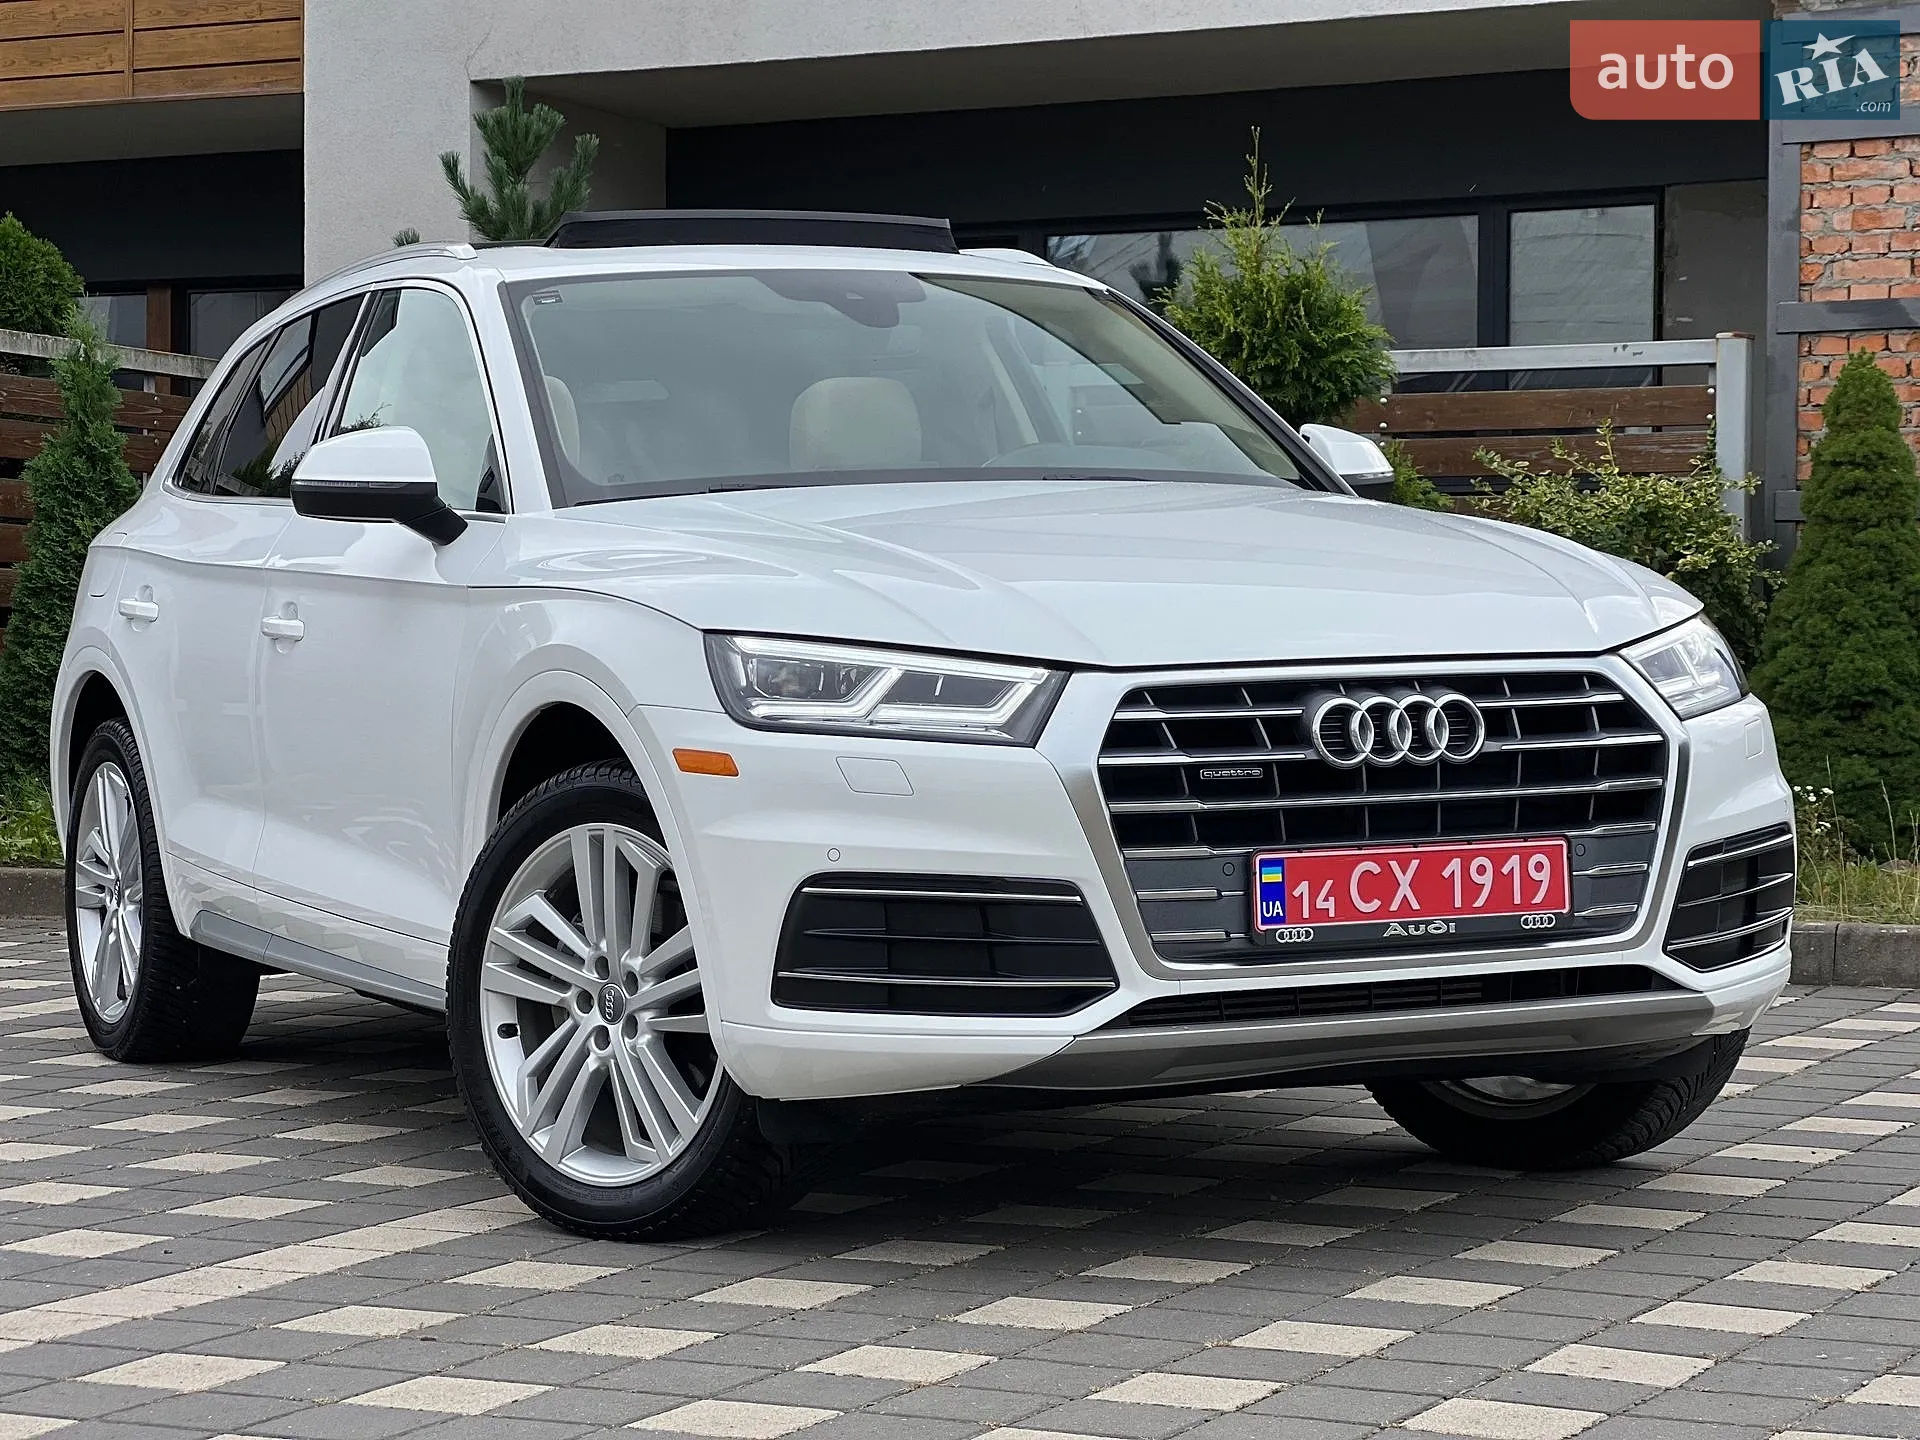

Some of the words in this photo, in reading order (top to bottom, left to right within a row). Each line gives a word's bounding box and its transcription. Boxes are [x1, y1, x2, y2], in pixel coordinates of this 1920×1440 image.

[1203, 768, 1261, 779] quattro
[1292, 879, 1336, 919] 14
[1349, 858, 1422, 914] CX
[1440, 853, 1552, 909] 1919
[1262, 900, 1284, 918] UA
[1383, 920, 1457, 938] Audi
